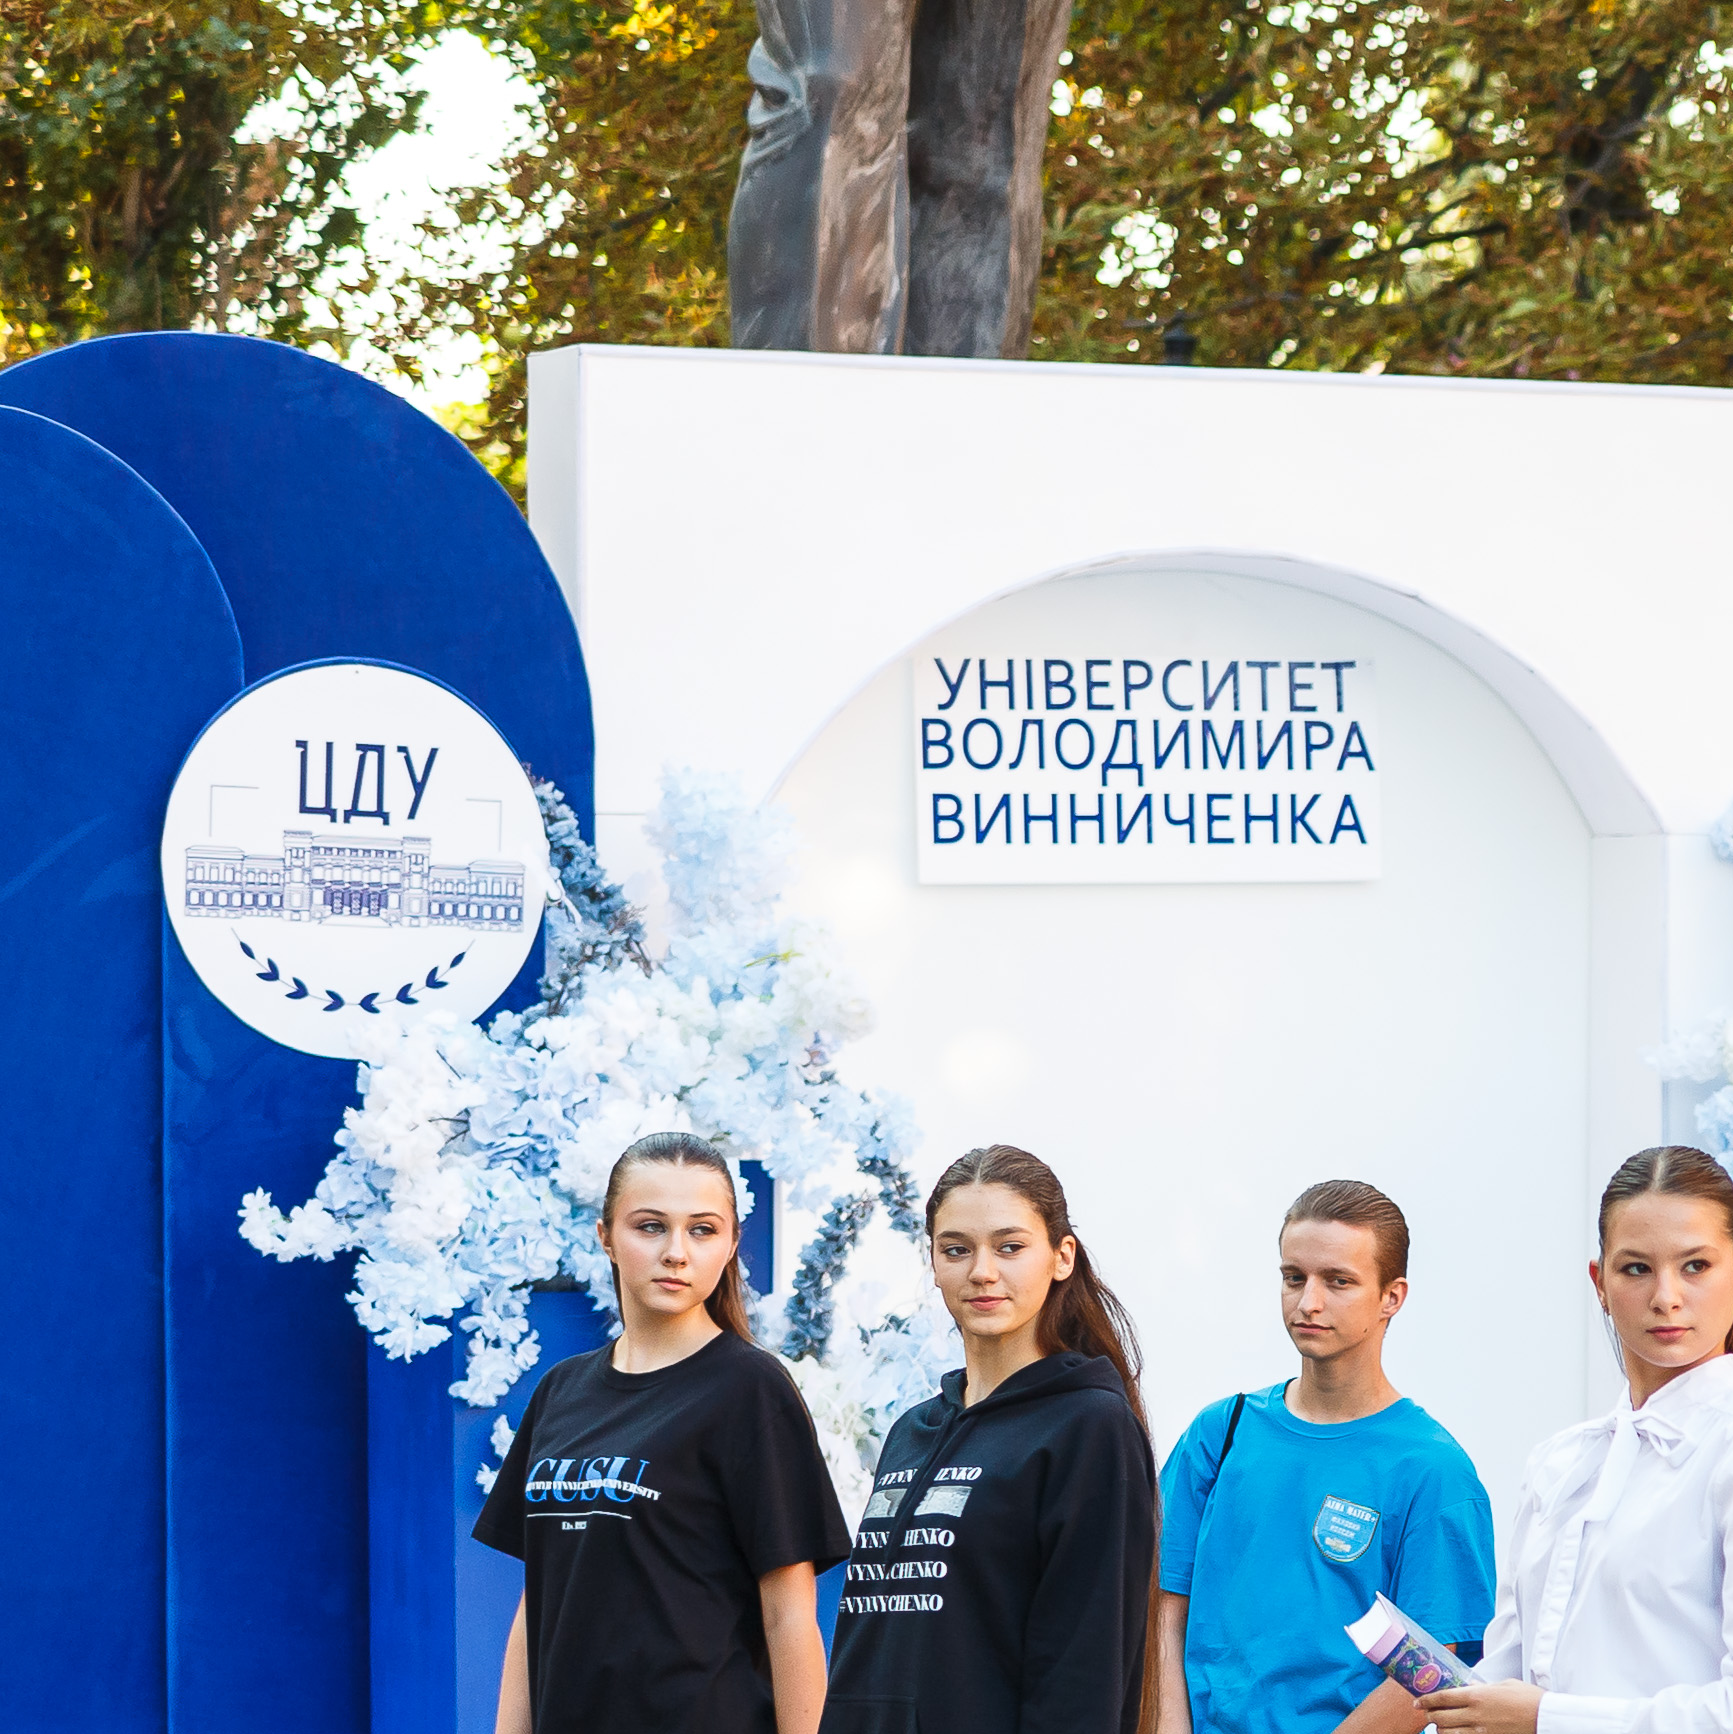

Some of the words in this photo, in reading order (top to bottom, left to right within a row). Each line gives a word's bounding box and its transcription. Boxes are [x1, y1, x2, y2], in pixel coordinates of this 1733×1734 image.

[933, 658, 1357, 713] УНІВЕРСИТЕТ
[921, 718, 1376, 787] ВОЛОДИМИРА
[295, 739, 439, 826] ЦДУ
[932, 793, 1368, 845] ВИННИЧЕНКА
[525, 1456, 650, 1502] CUSU
